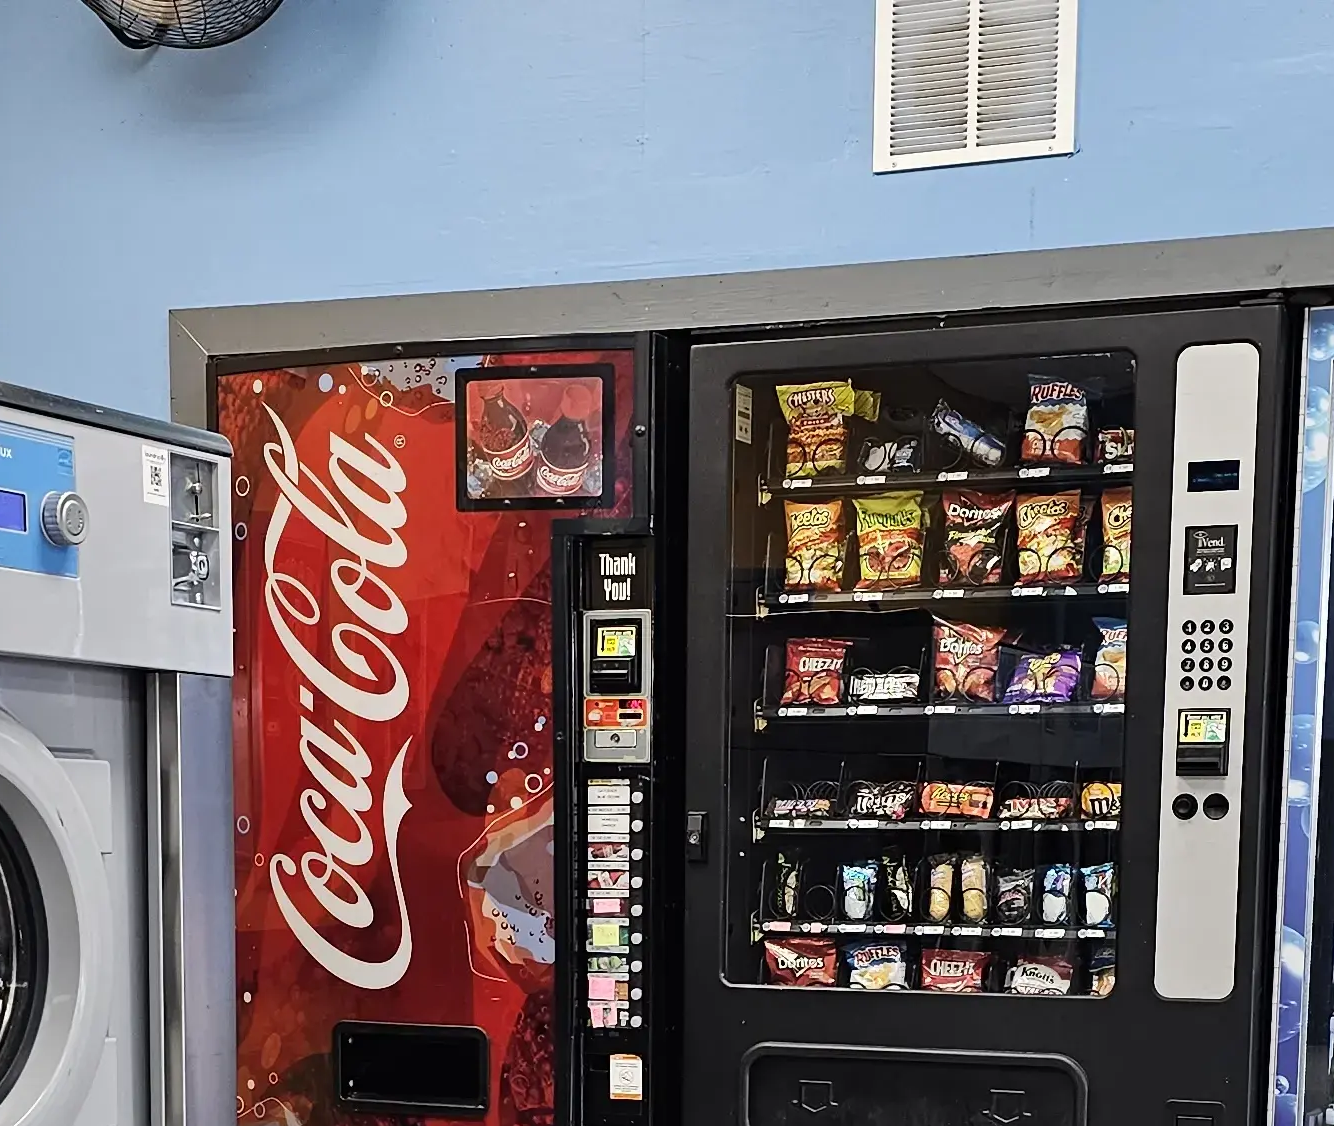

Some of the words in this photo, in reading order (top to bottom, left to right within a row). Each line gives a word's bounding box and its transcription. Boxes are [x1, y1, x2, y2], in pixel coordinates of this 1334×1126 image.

[1031, 382, 1085, 403] RUFFLES
[598, 553, 636, 576] Thank
[603, 578, 631, 601] You!
[1203, 622, 1211, 632] 2
[1222, 621, 1230, 632] 3
[1184, 641, 1192, 651] 4
[1203, 640, 1211, 651] 5
[1222, 640, 1229, 650] 6
[1203, 659, 1210, 670] 8
[1221, 659, 1229, 669] 9
[262, 402, 413, 990] Coca-Cola
[778, 956, 824, 970] Doritos
[854, 946, 901, 966] RUFFLES
